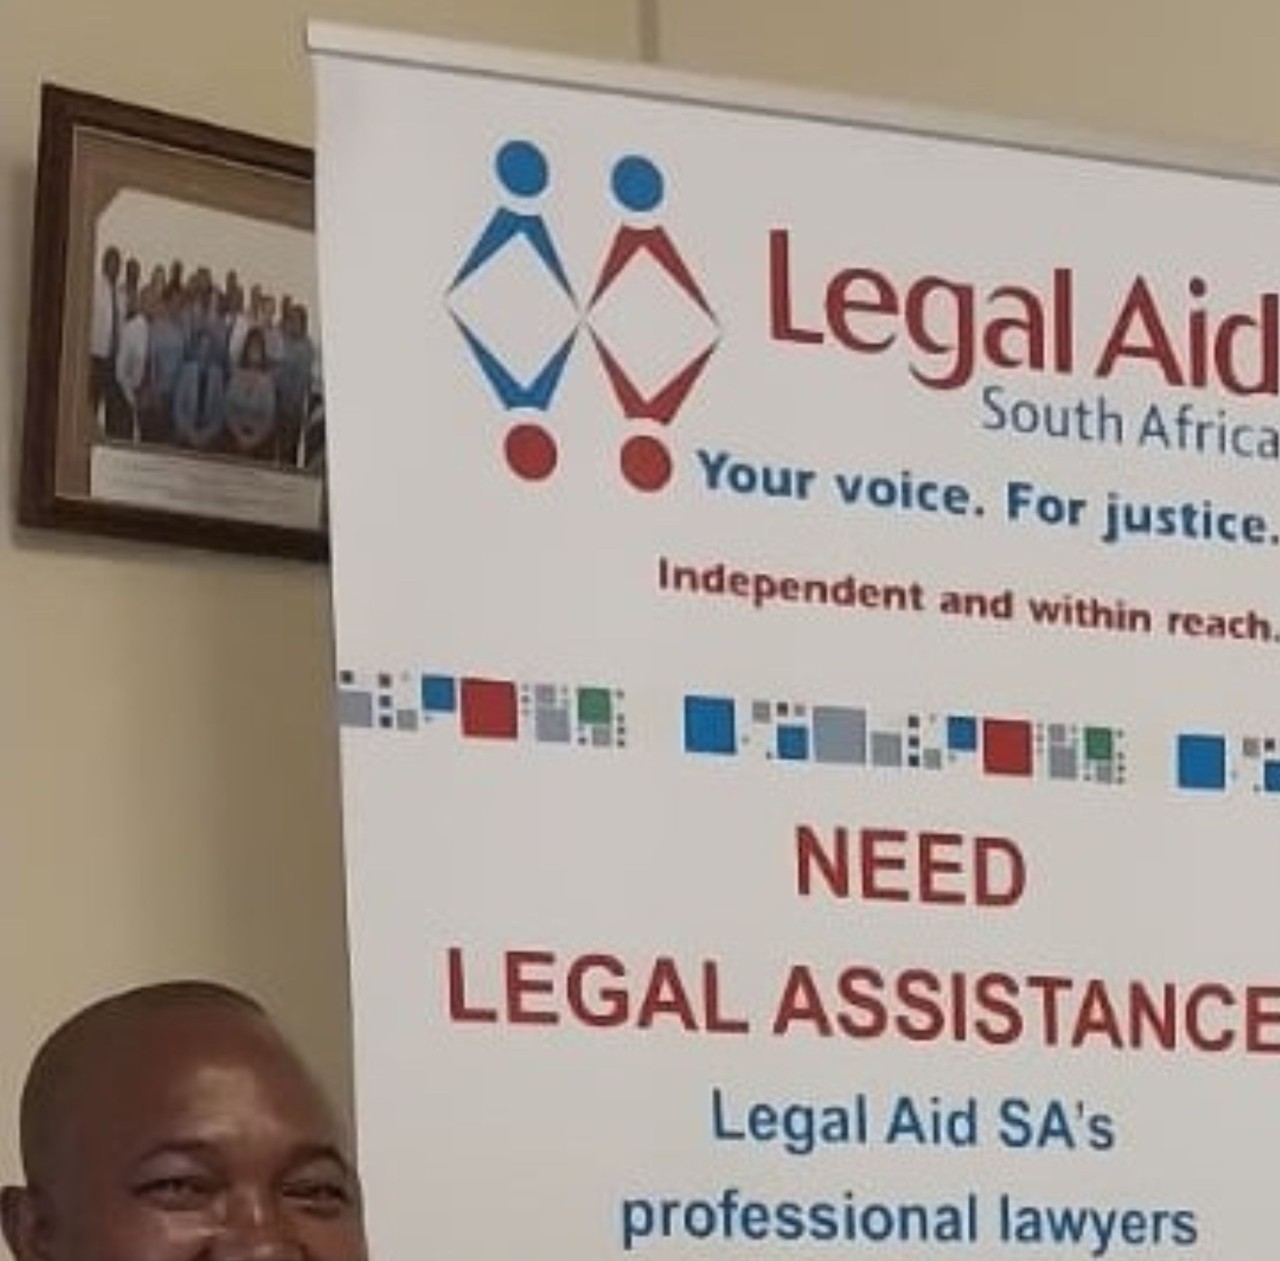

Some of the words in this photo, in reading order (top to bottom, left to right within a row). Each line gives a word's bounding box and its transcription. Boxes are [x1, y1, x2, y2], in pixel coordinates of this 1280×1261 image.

[769, 229, 1074, 390] Legal
[1095, 274, 1280, 396] Aid
[982, 385, 1123, 445] South
[1138, 391, 1280, 460] Africa
[695, 448, 817, 501] Your
[834, 469, 985, 518] voice.
[1007, 481, 1088, 527] For
[1100, 491, 1280, 546] justice.
[658, 556, 925, 612] Independent
[939, 585, 1014, 621] and
[1028, 595, 1152, 633] within
[795, 824, 1027, 908] NEED
[447, 946, 750, 1035] LEGAL
[712, 1087, 868, 1156] Legal
[885, 1095, 978, 1148] Aid
[998, 1097, 1115, 1152] SA's
[622, 1187, 978, 1252] professional
[999, 1193, 1198, 1259] lawyers
